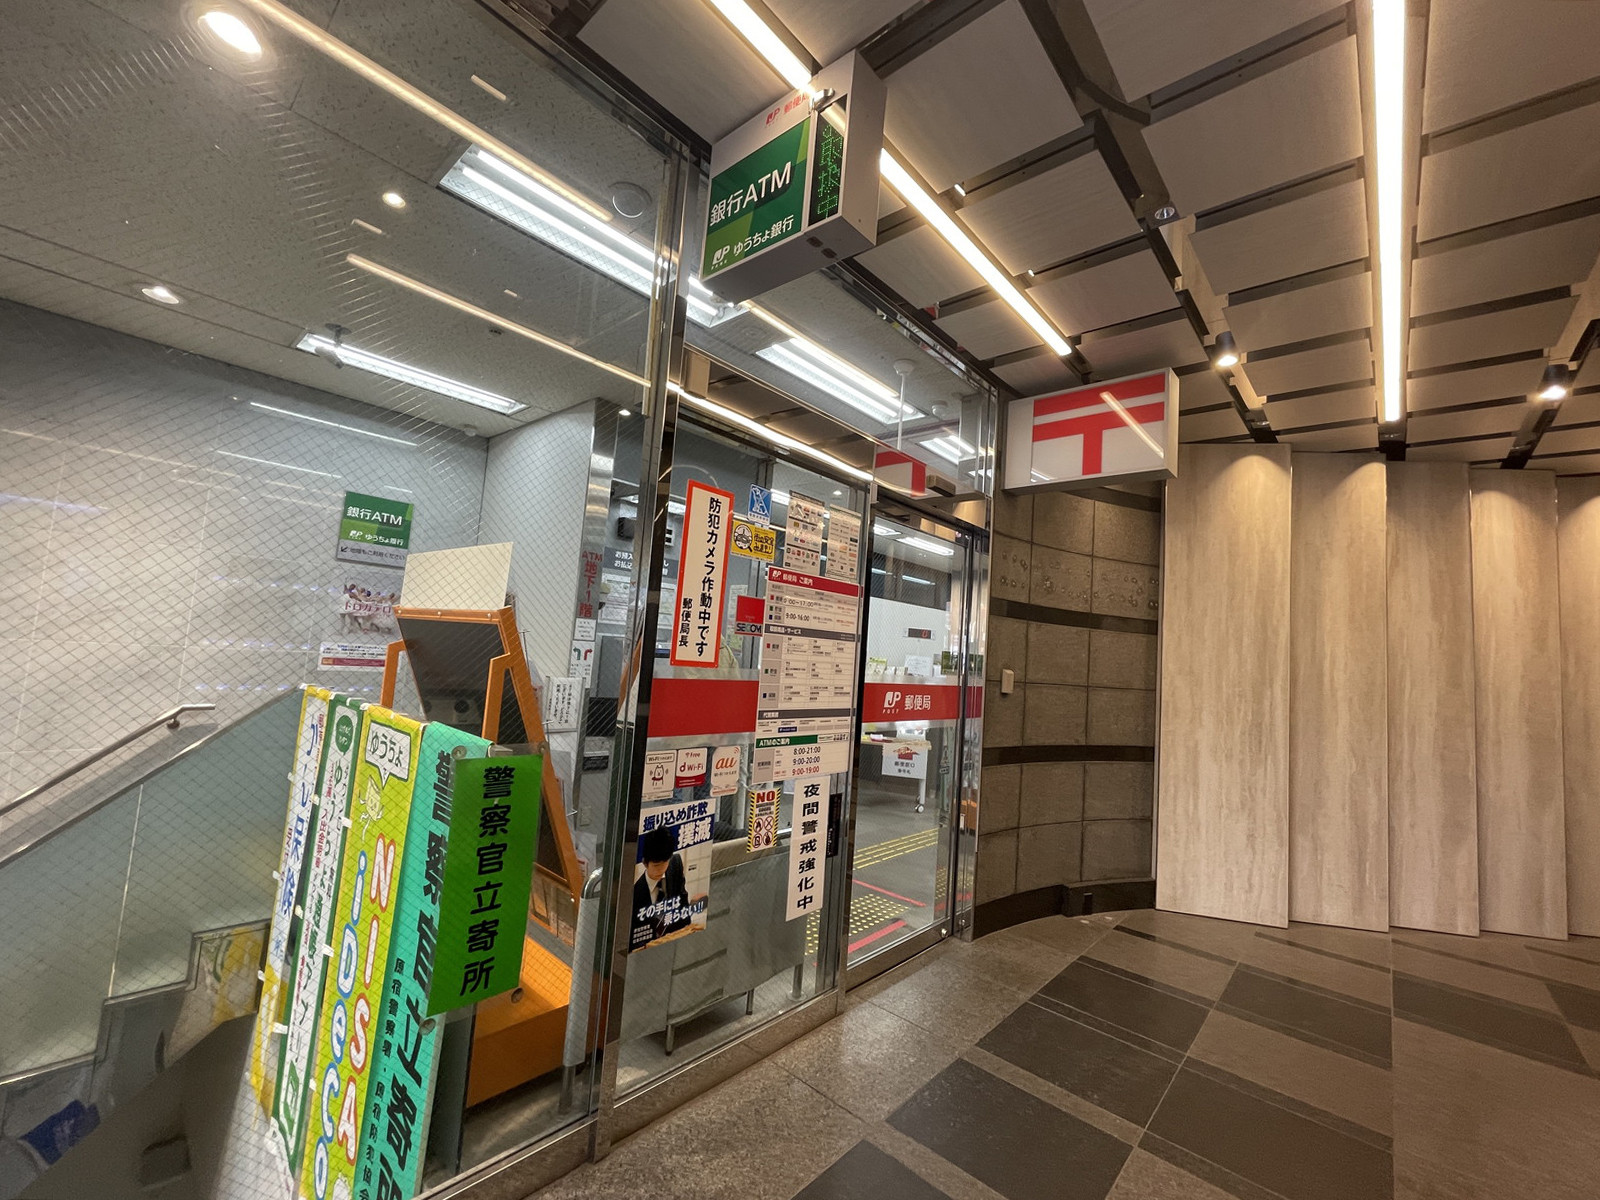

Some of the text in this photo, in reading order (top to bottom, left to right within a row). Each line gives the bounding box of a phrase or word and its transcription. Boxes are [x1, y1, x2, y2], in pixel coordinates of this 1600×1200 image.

[709, 160, 792, 227] 銀行ATM
[733, 214, 795, 257] ゆうちょ銀行
[346, 506, 403, 526] 銀行ATM
[365, 534, 404, 546] ゆうちょ銀行
[581, 550, 603, 561] ATM
[695, 496, 722, 657] 防犯カメラ作動中です
[579, 562, 599, 618] 地下1階
[678, 597, 693, 647] 郵便局長
[736, 622, 762, 634] SECOM
[904, 694, 931, 711] 郵便局
[370, 727, 404, 767] ゆうちょ
[758, 738, 790, 747] ATMのご案内
[793, 746, 821, 756] 8:00-21:00
[687, 763, 704, 772] Wi-Fi
[715, 757, 737, 770] au
[791, 766, 820, 776] 9:00-19:00
[792, 756, 821, 766] 9:00-20:00
[756, 791, 775, 803] NO
[643, 801, 708, 833] 振り込め詐欺
[677, 817, 711, 850] 撲滅
[796, 783, 821, 910] 夜間警戒強化中
[459, 765, 516, 997] 警察官立寄所
[637, 896, 681, 922] その手には
[337, 832, 397, 1167] NISA
[314, 850, 368, 1200] iDeCo
